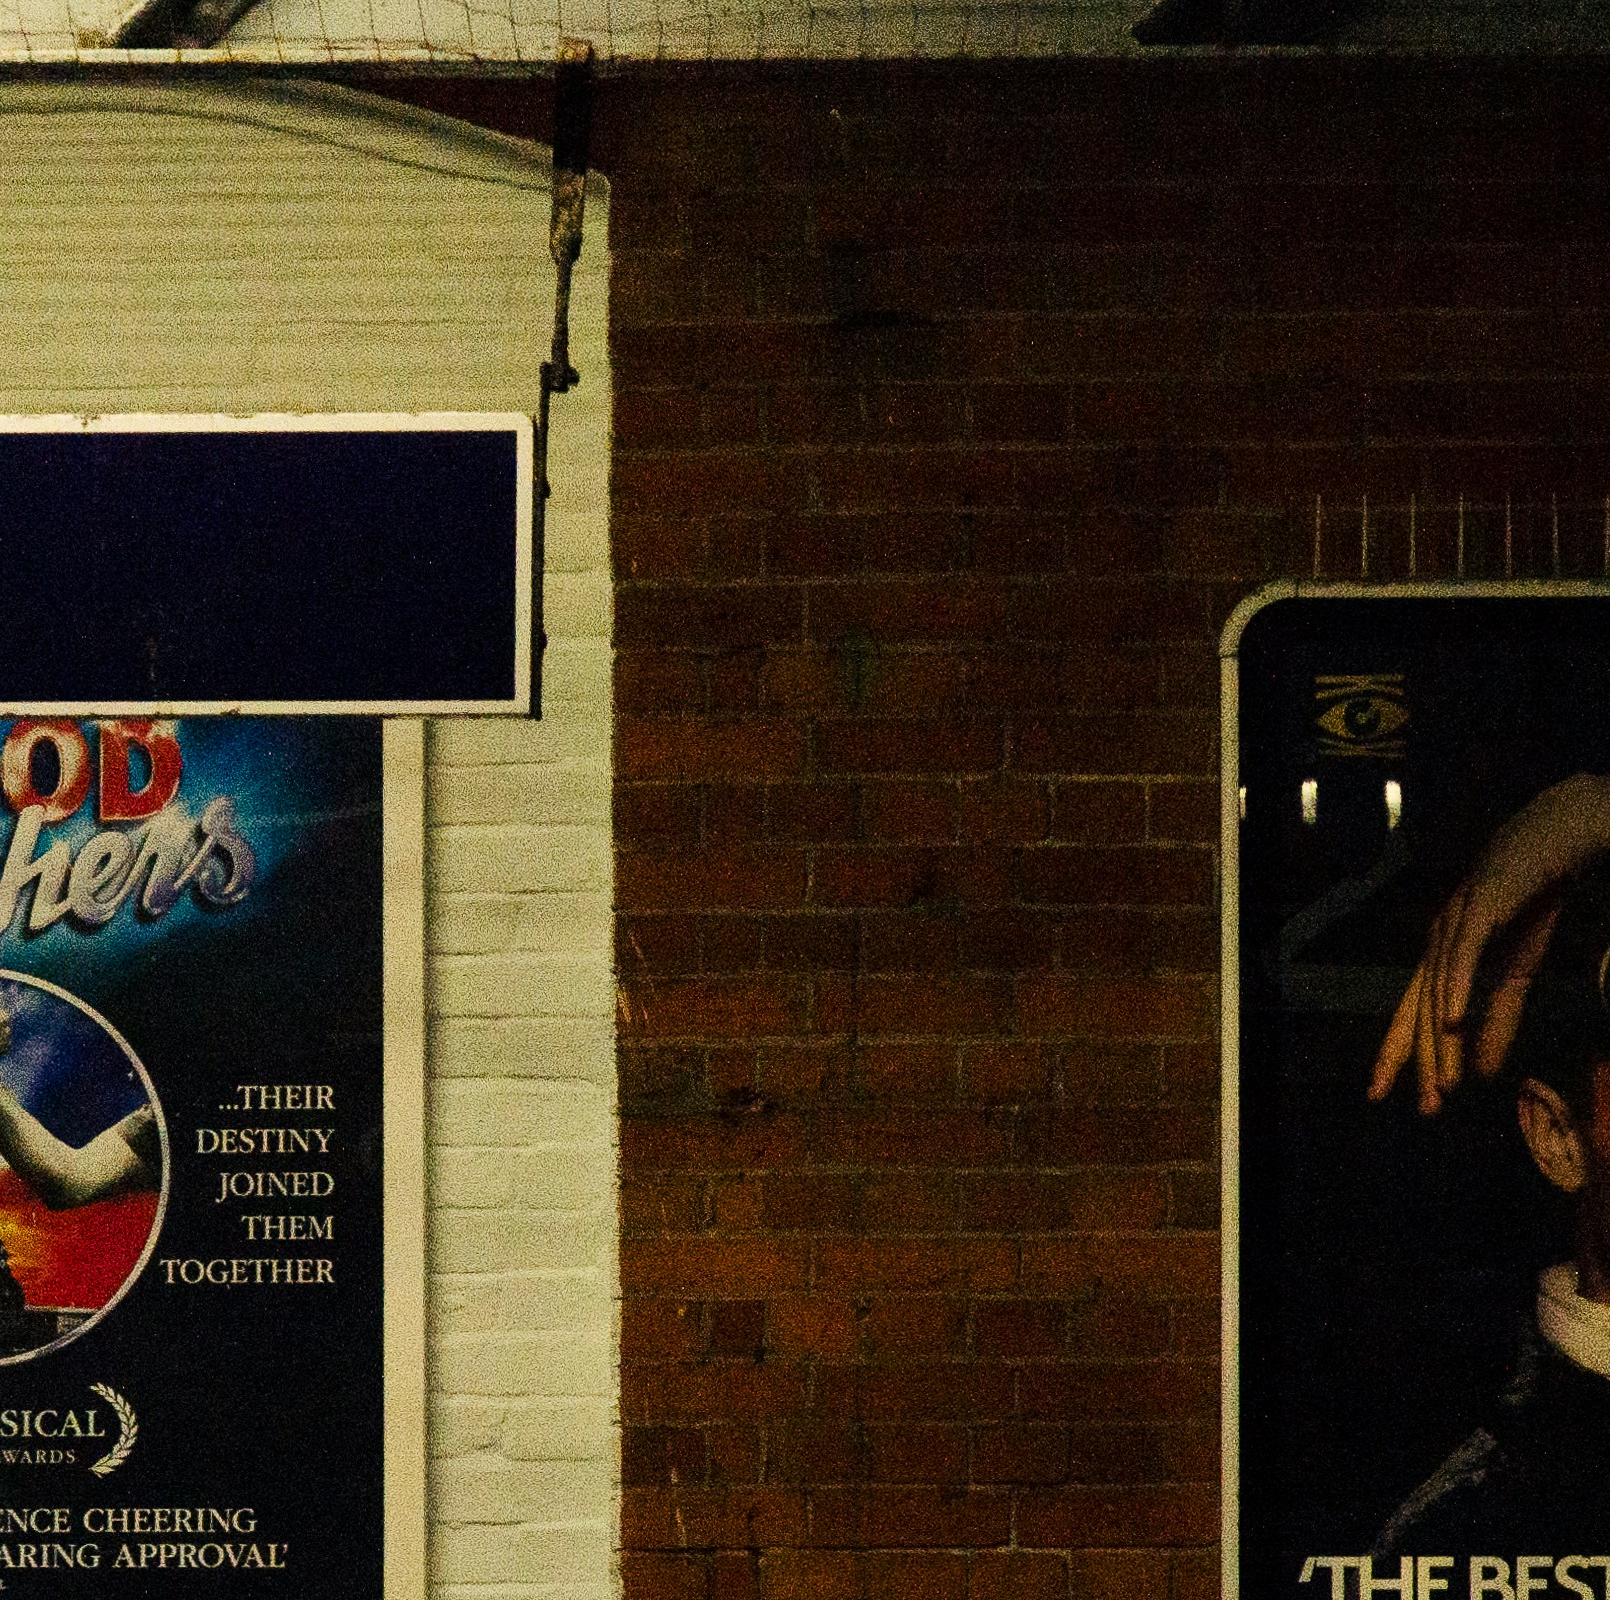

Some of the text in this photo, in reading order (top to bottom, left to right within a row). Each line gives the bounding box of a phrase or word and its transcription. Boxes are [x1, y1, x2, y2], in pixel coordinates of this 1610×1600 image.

[219, 1086, 334, 1109] ...THEIR
[198, 1129, 333, 1153] DESTINY
[216, 1172, 334, 1203] JOINED
[242, 1216, 333, 1240] THEM
[160, 1259, 334, 1283] TOGETHER
[84, 1508, 256, 1532] CHEERING
